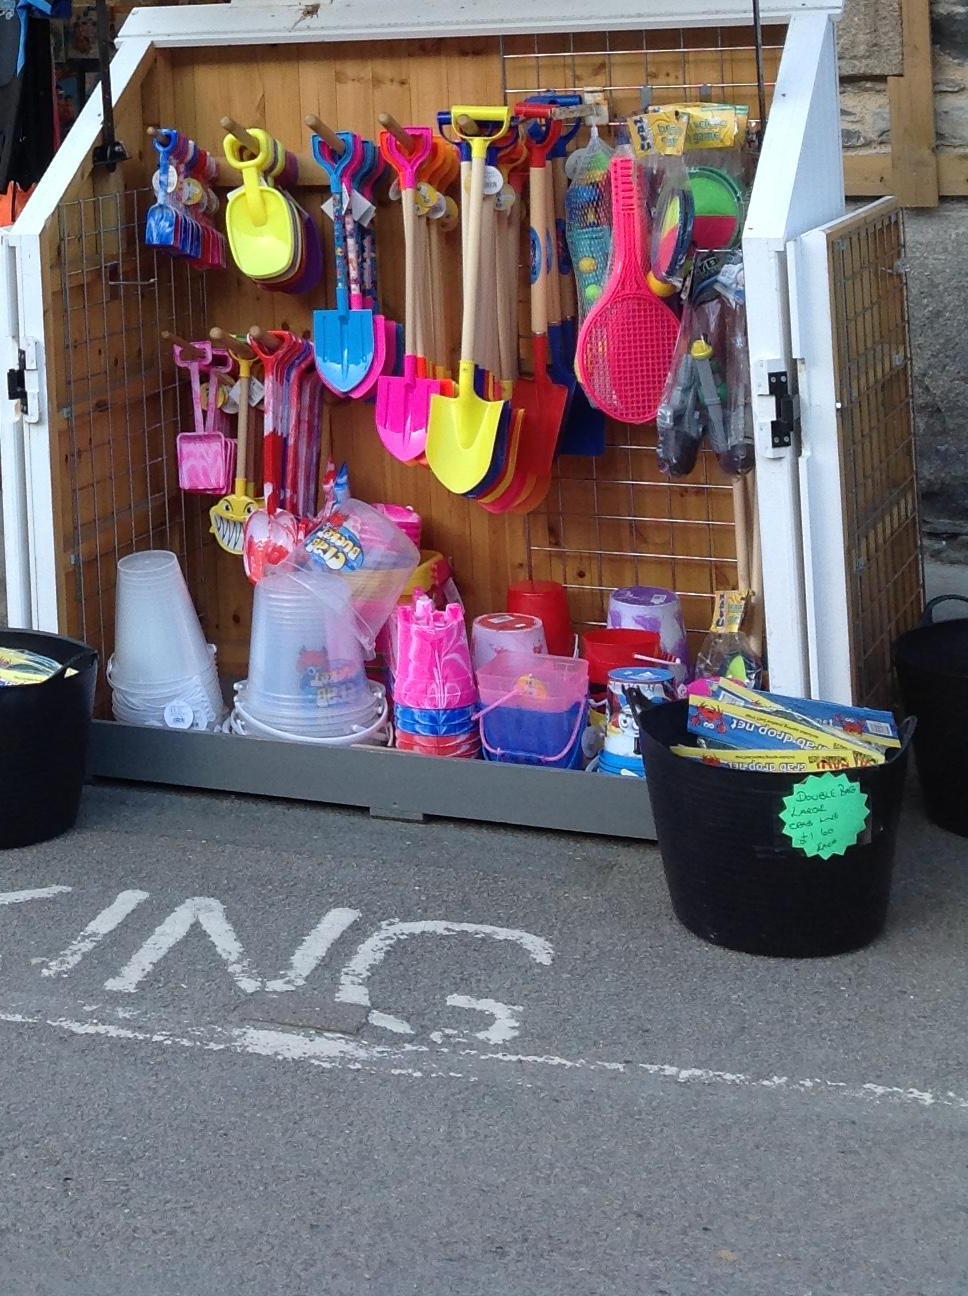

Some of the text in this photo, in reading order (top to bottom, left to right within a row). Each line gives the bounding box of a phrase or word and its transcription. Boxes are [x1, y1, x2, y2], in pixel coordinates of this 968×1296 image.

[729, 717, 755, 733] net
[759, 725, 793, 744] drop
[796, 790, 836, 802] DOUBLE
